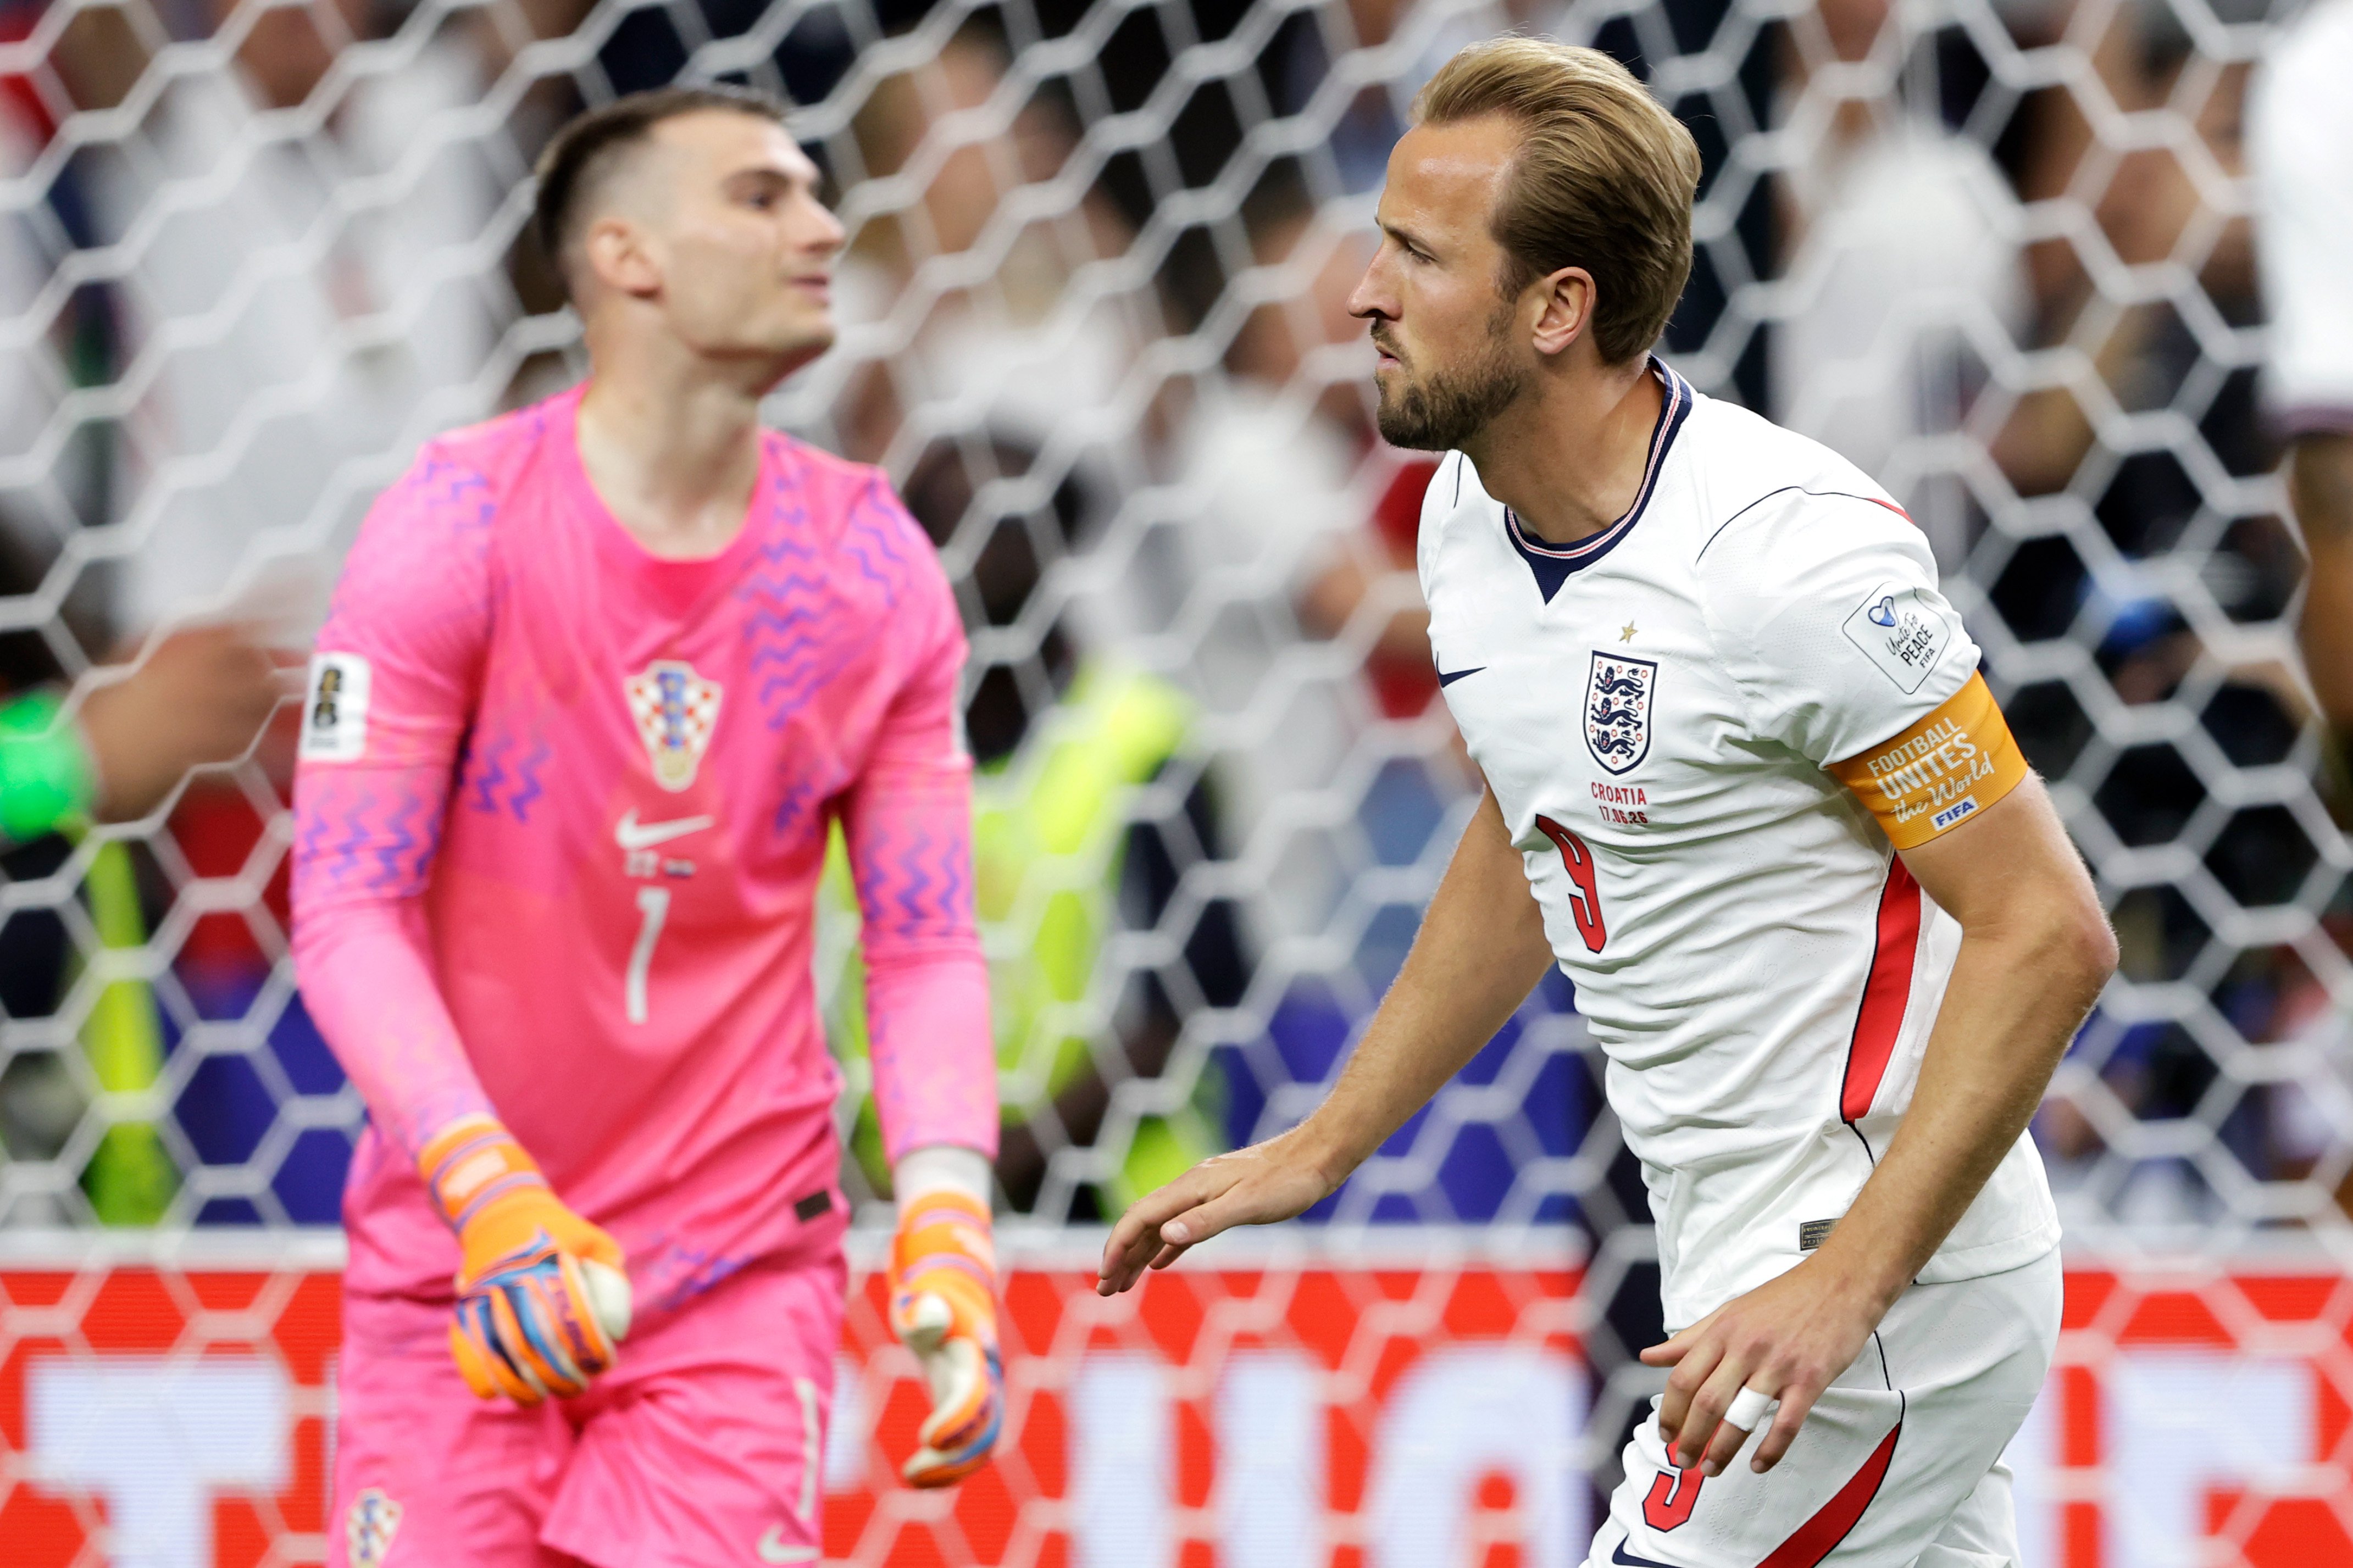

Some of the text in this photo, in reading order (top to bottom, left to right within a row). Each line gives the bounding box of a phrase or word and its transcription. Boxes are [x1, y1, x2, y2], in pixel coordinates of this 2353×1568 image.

[1900, 624, 1933, 666] PEACE
[1919, 648, 1936, 668] FIFA
[1867, 717, 1962, 777] FOOTBALL
[1876, 732, 1977, 800] UNITES
[1591, 781, 1647, 805] CROATIA
[1890, 750, 1995, 823] the World
[1599, 805, 1648, 824] 17.06.26
[1935, 801, 1974, 826] FIFA
[1535, 814, 1607, 954] 9
[625, 886, 670, 1024] 1
